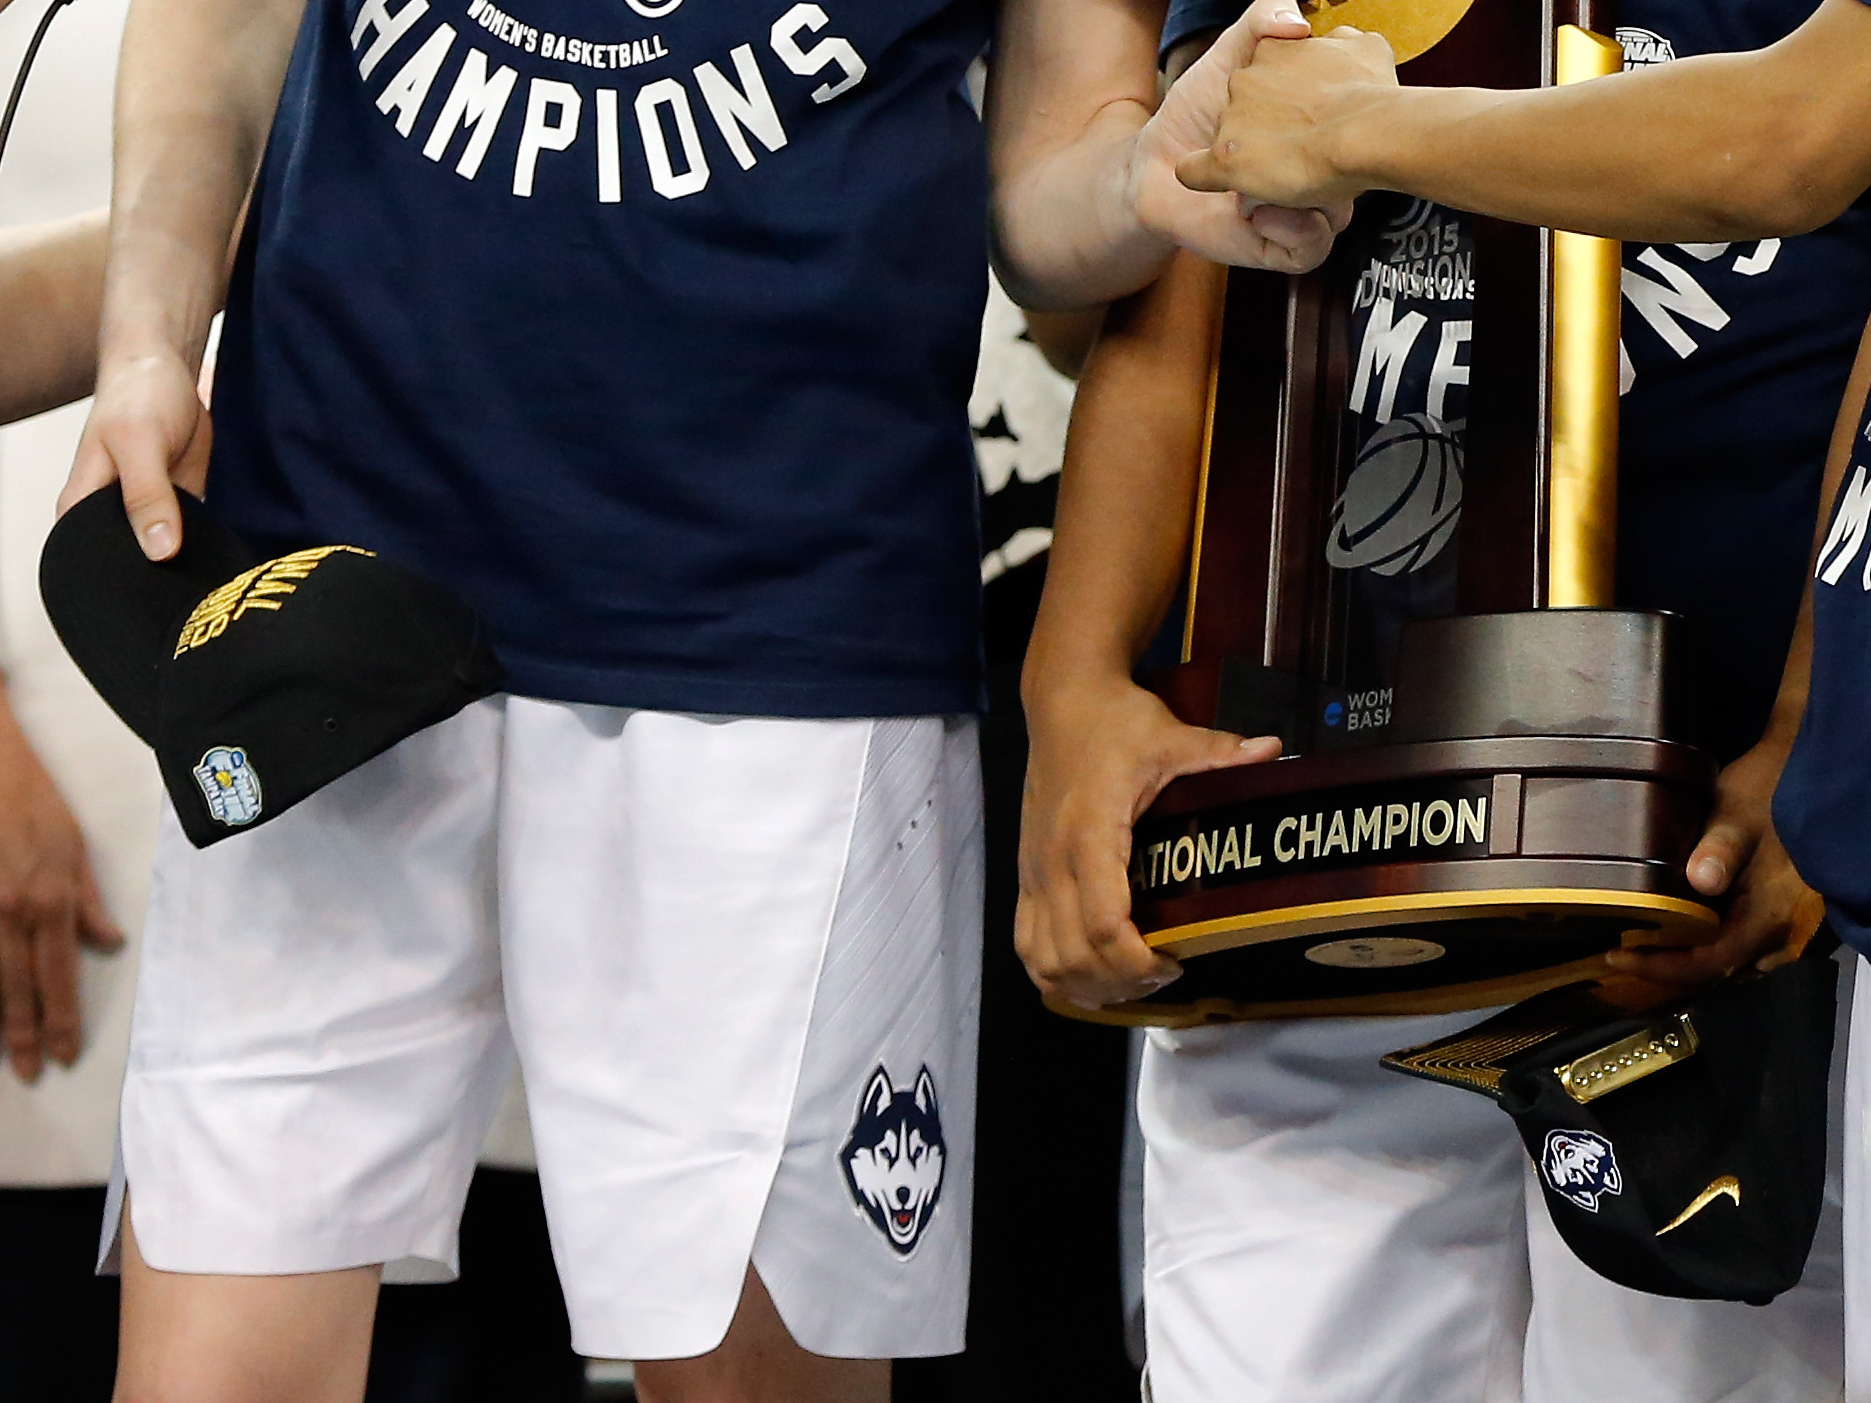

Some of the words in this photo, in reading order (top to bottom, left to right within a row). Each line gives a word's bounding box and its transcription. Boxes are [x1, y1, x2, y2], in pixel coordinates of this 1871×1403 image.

[541, 32, 669, 70] BASKETBALL
[1130, 823, 1262, 891] ATIONAL
[1274, 797, 1487, 863] CHAMPION
